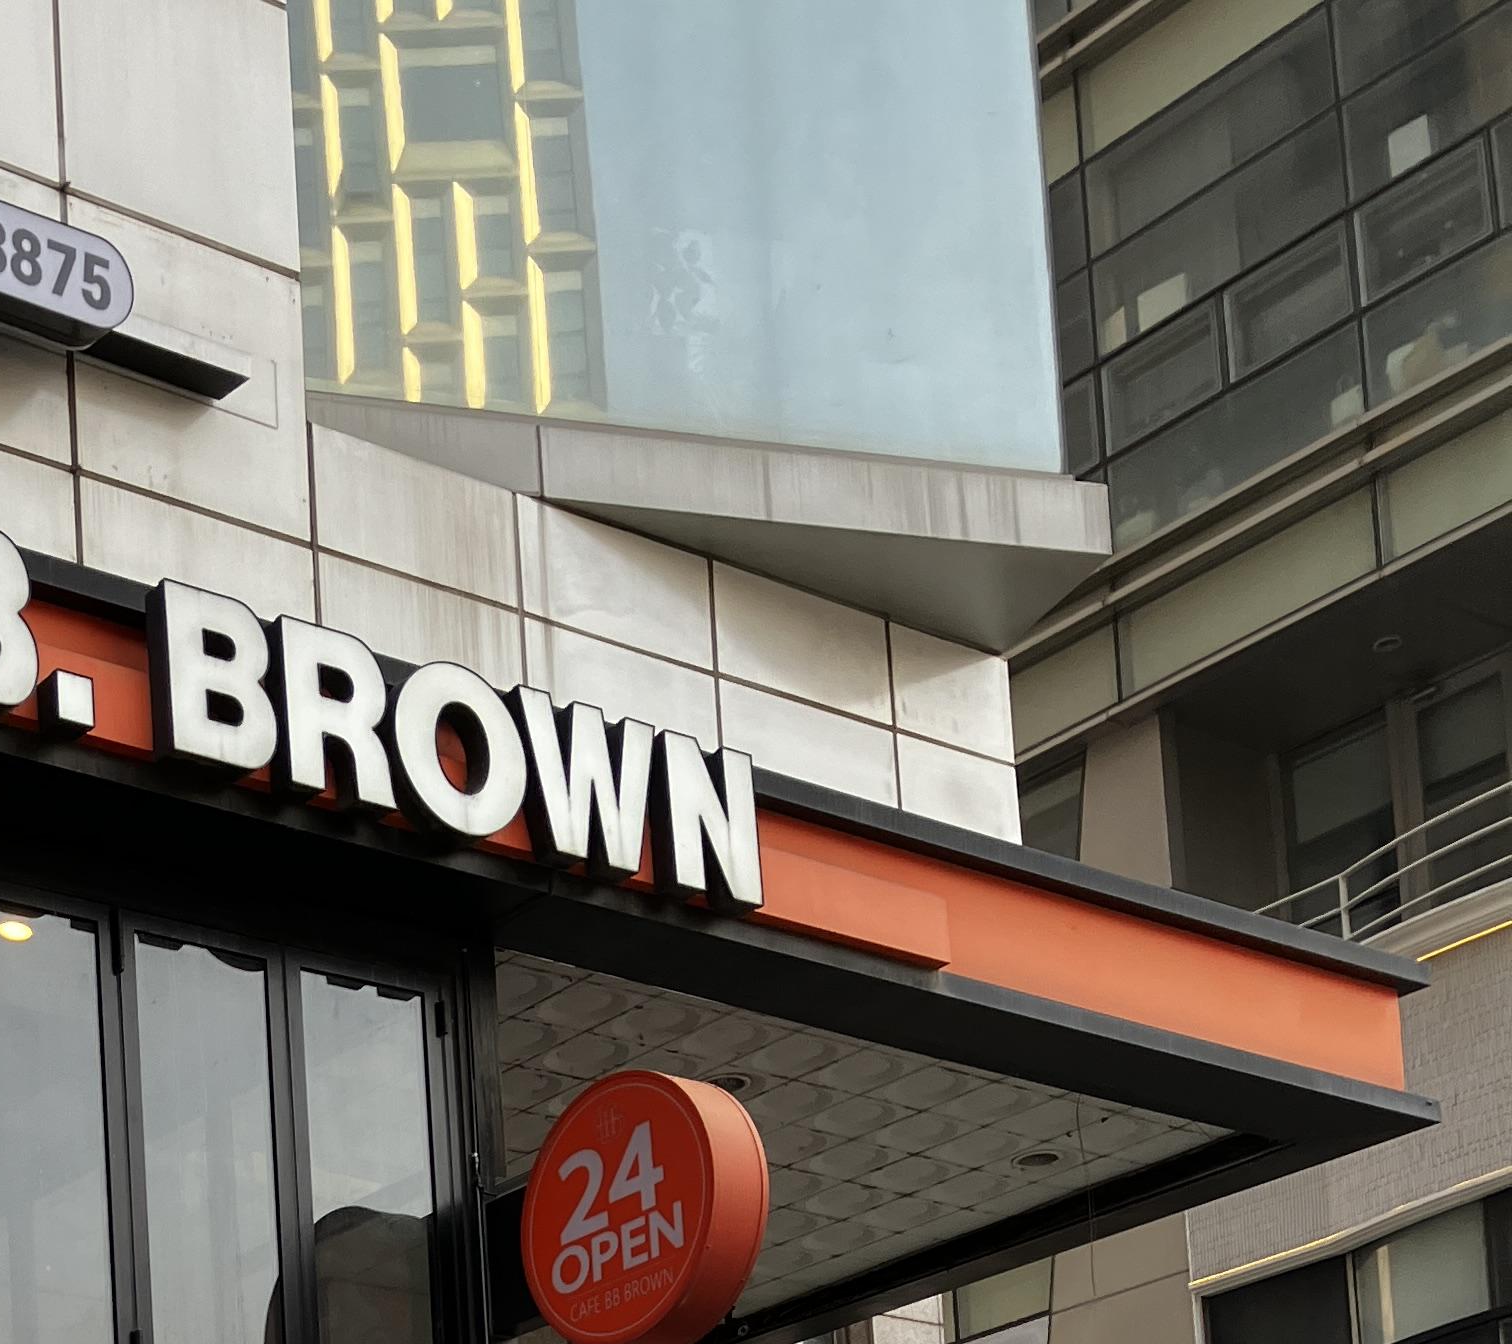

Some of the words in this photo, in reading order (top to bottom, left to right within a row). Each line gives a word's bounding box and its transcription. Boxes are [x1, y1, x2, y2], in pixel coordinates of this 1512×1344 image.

[152, 578, 763, 911] BROWN
[558, 1120, 664, 1246] 24
[551, 1200, 684, 1294] OPEN
[570, 1294, 600, 1322] CAFE
[605, 1289, 621, 1310] BB
[624, 1267, 674, 1302] BROWN
